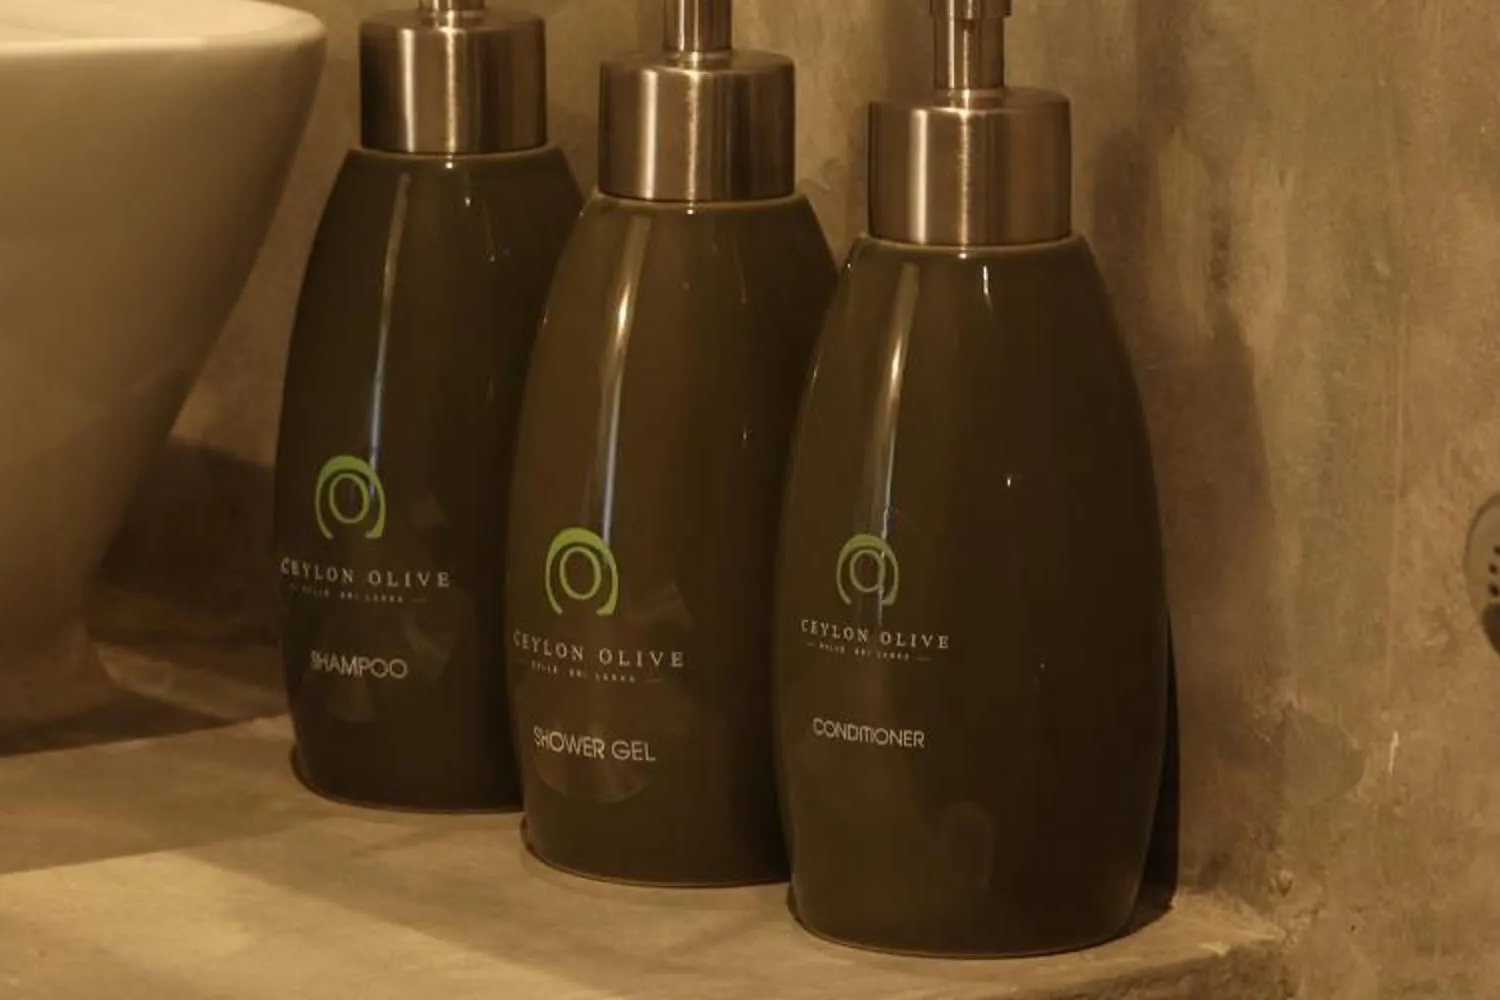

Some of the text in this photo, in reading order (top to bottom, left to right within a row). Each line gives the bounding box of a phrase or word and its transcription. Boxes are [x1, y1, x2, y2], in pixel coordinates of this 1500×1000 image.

[281, 557, 450, 588] CEYLON OLIVE
[513, 630, 684, 668] CEYLON OLIVE
[801, 619, 950, 649] CEYLON OLIVE
[311, 650, 408, 679] SHAMPOO
[533, 726, 657, 762] SHOWER GEL
[812, 717, 925, 748] CONDITIONER
